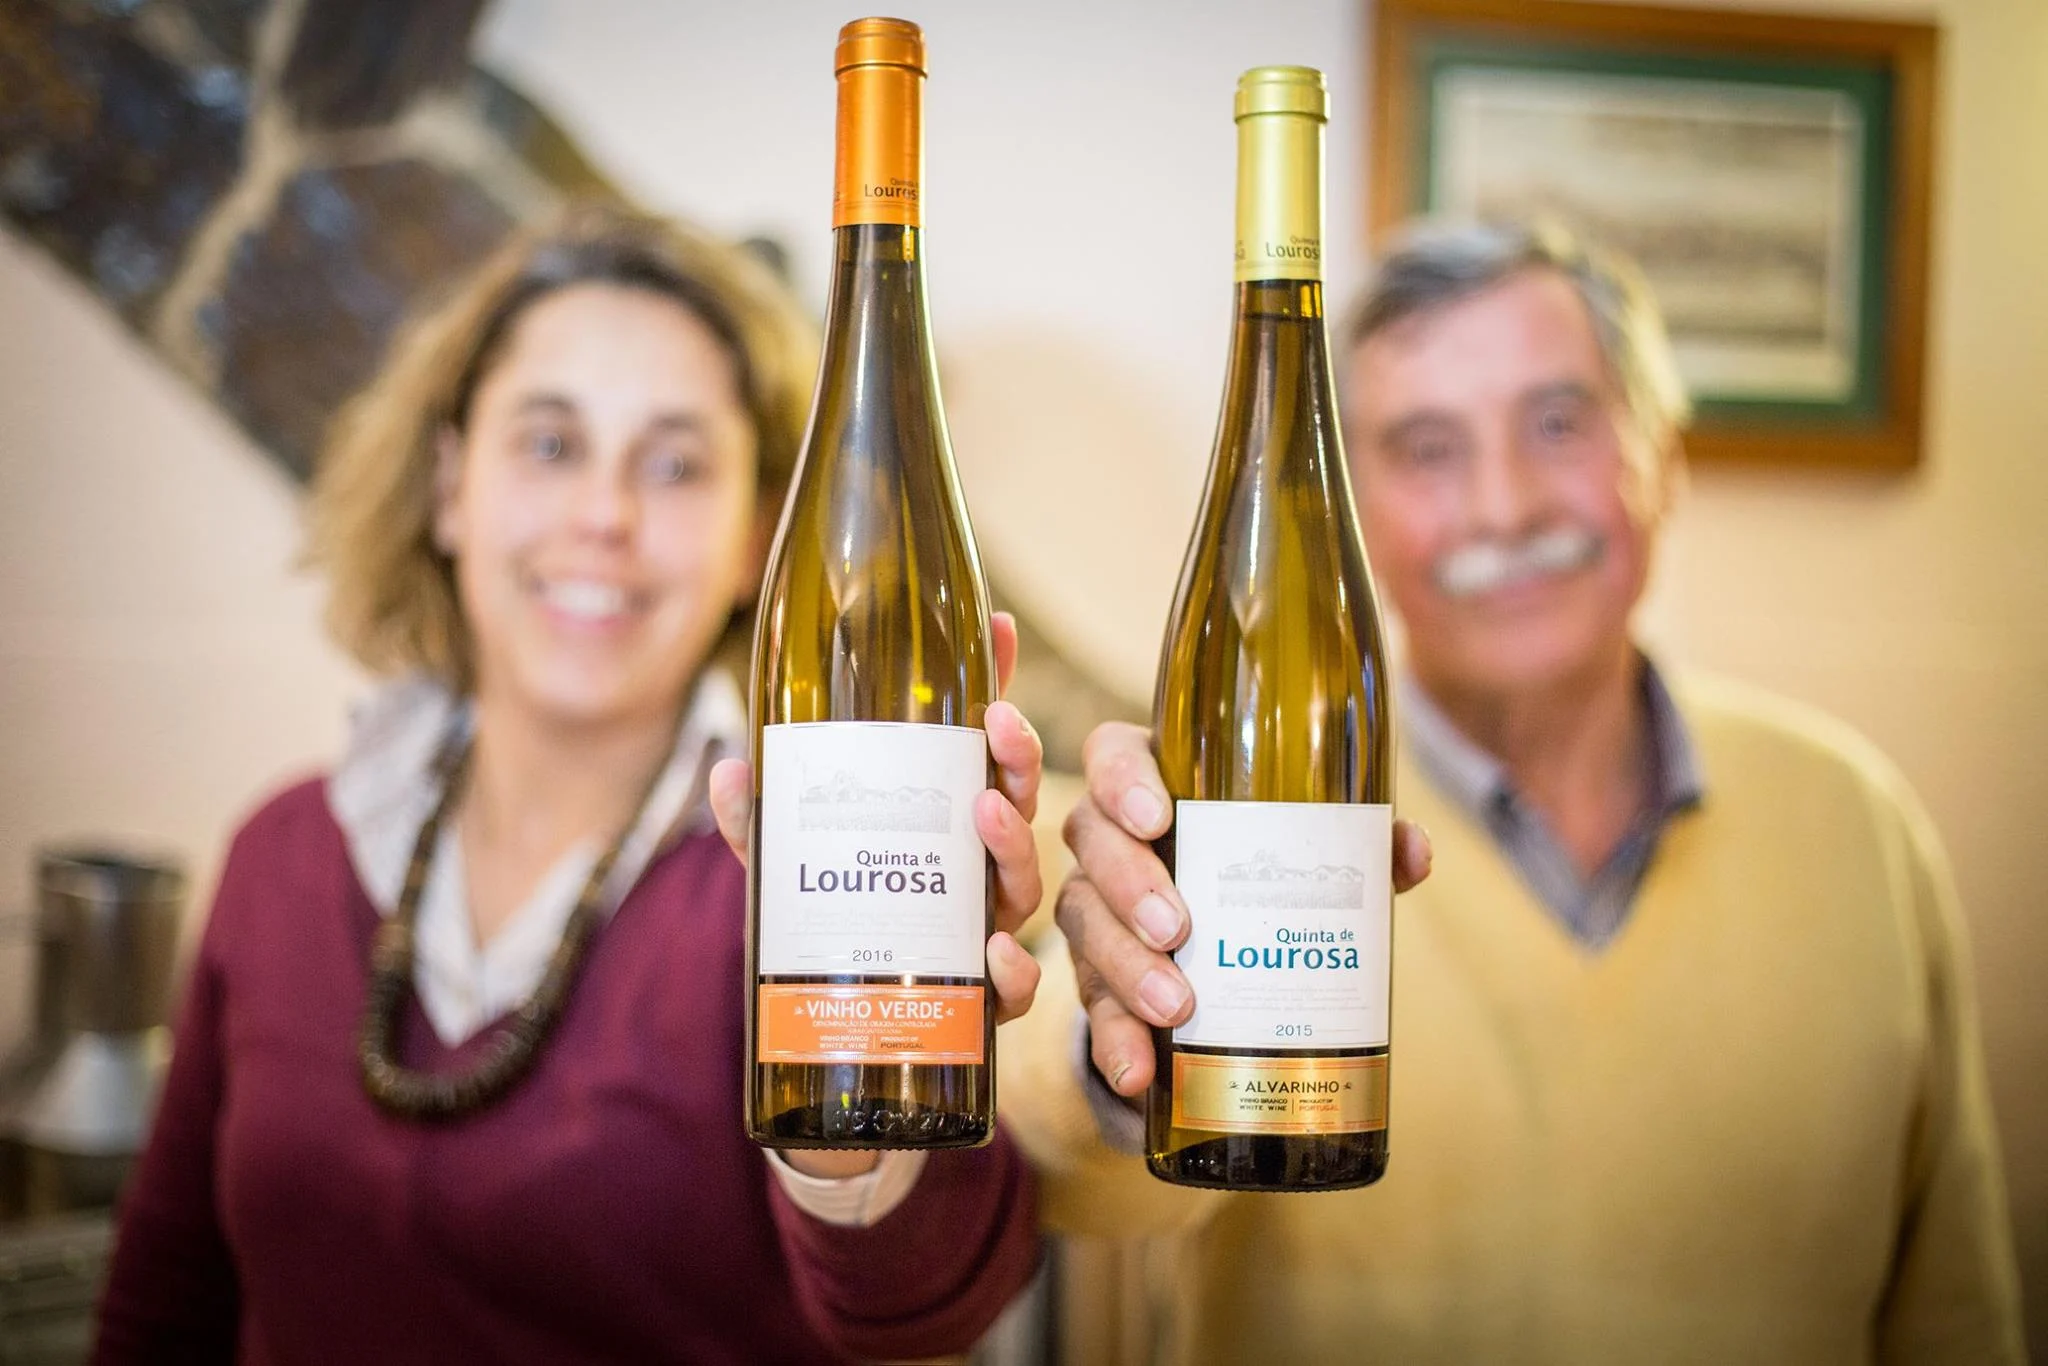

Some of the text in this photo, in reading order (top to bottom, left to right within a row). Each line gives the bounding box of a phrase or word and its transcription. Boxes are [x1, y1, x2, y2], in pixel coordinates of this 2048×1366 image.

[865, 184, 918, 200] Louros
[1266, 242, 1320, 260] Louros
[857, 850, 941, 867] Quinta de
[800, 863, 947, 894] Lourosa
[1276, 928, 1354, 944] Quinta de
[853, 950, 893, 962] 2016
[1218, 939, 1359, 969] Lourosa
[806, 1000, 944, 1019] VINHO VERDE
[1275, 1025, 1313, 1036] 2015
[1245, 1081, 1340, 1093] ALVARINHO
